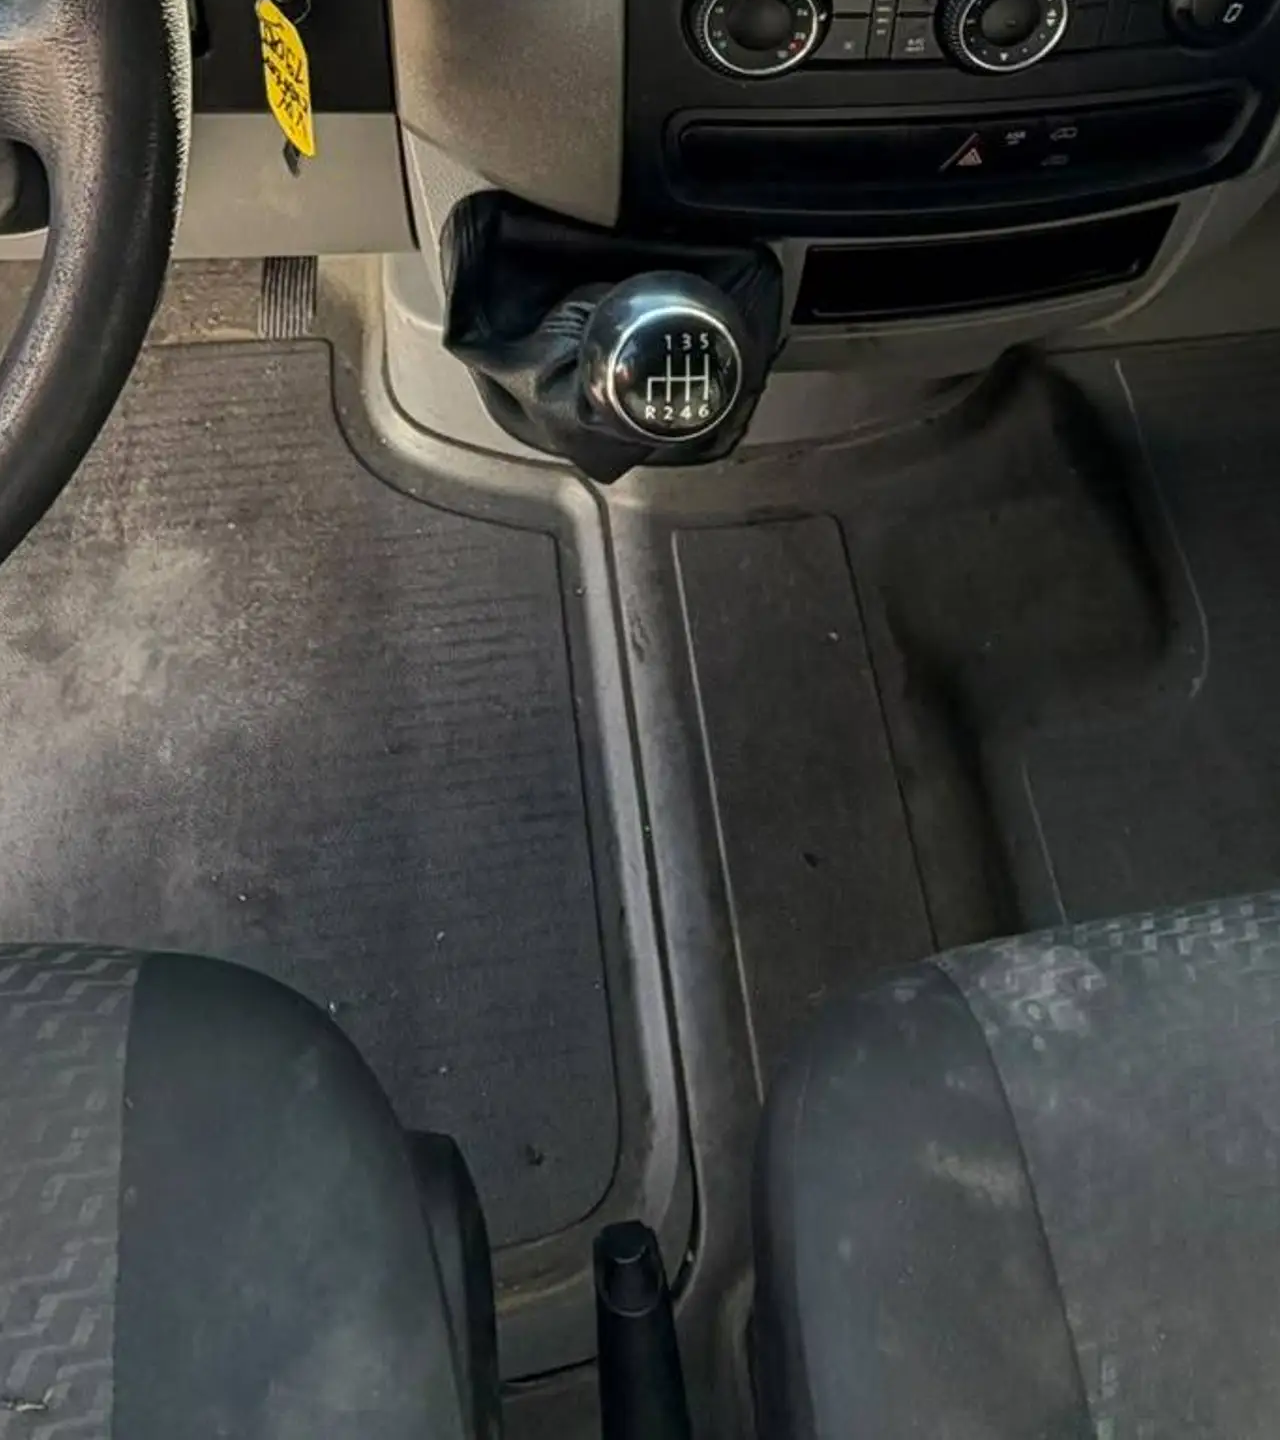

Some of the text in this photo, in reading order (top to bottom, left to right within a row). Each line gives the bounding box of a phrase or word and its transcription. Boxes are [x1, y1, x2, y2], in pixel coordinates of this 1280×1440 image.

[664, 331, 710, 351] 1 3 5
[644, 404, 709, 421] R 2 4 6
